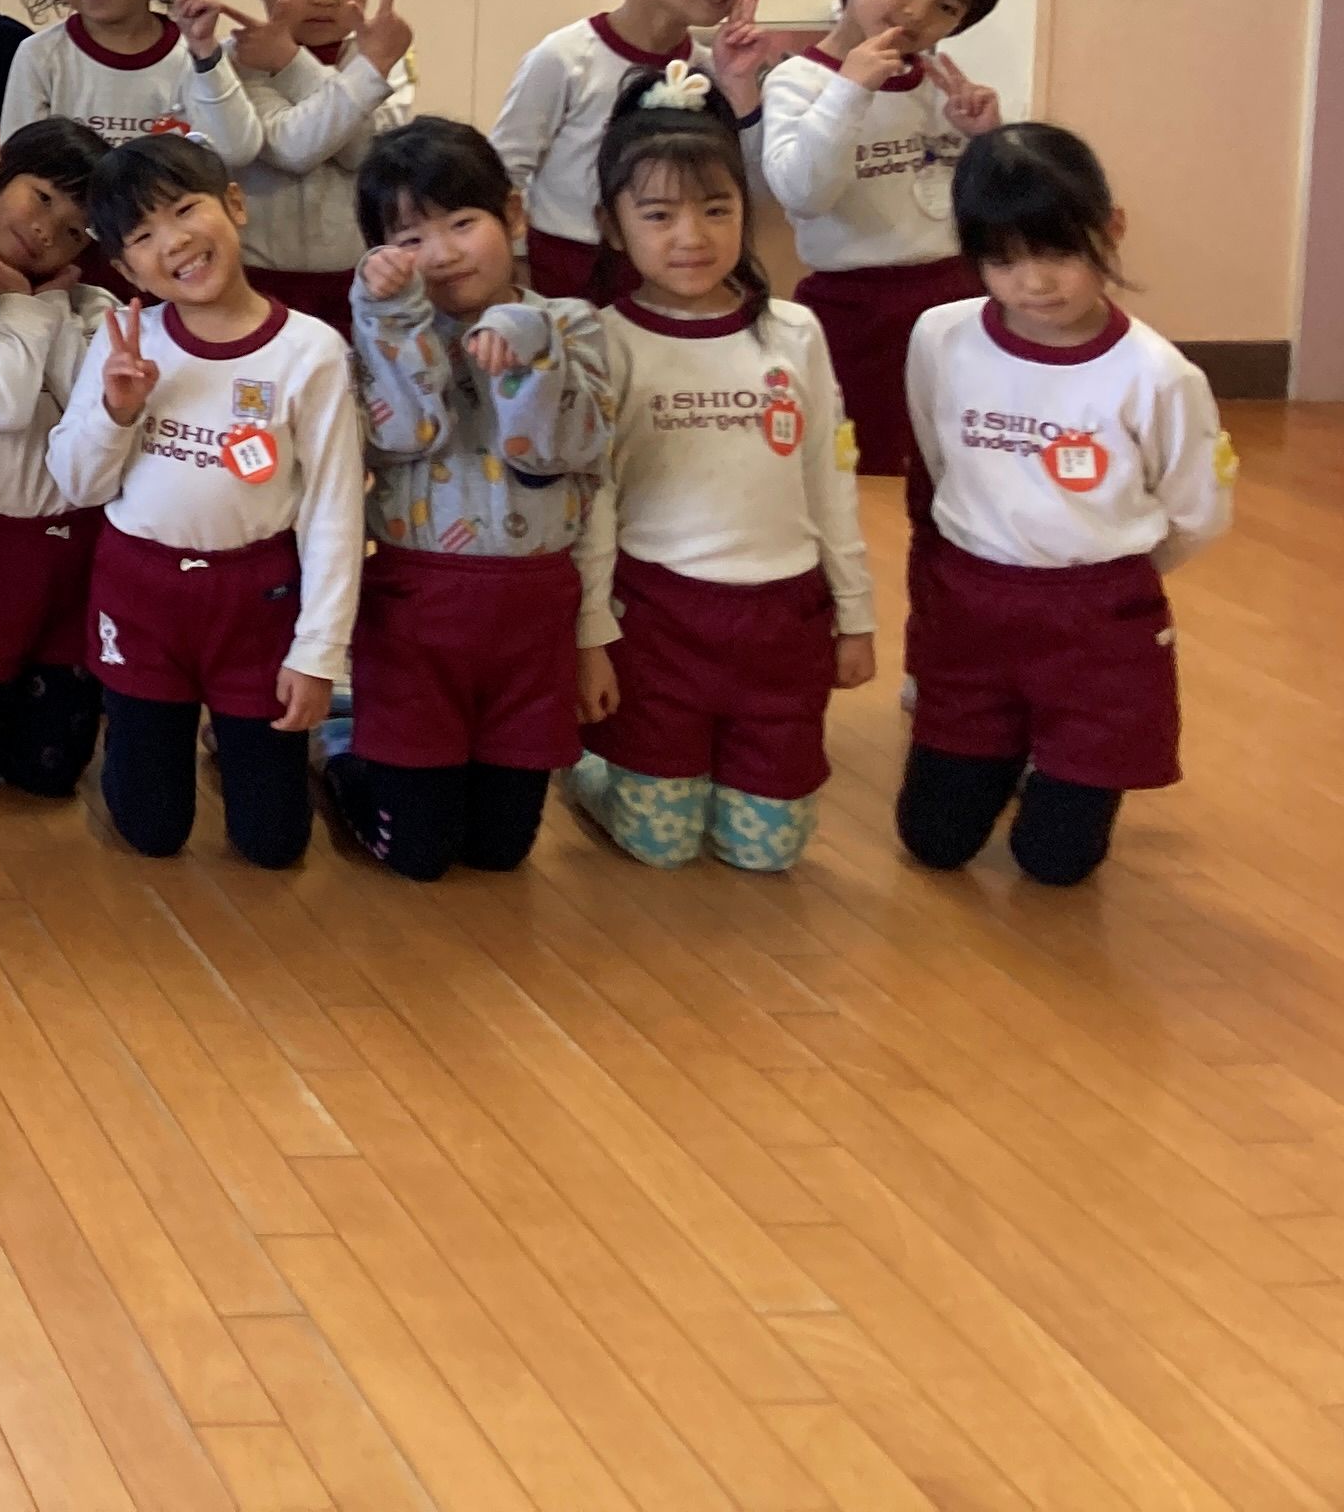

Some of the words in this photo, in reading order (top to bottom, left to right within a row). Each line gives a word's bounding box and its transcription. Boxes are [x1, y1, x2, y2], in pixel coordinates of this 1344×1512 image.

[88, 116, 153, 133] SHIO
[653, 409, 765, 431] kindergart
[984, 412, 1062, 441] SHIO
[141, 437, 225, 468] kinderga
[963, 431, 1044, 457] kinderga
